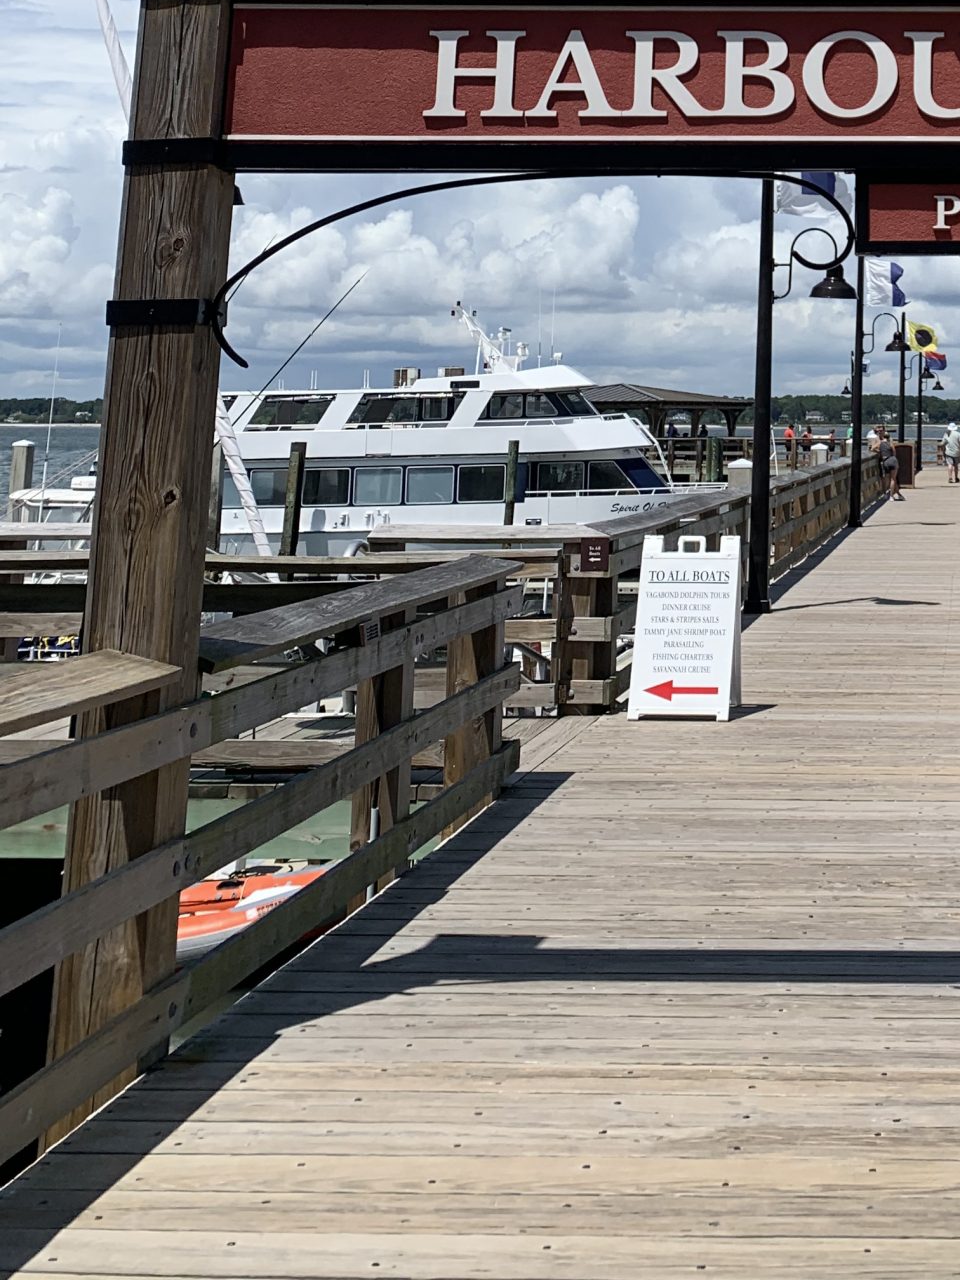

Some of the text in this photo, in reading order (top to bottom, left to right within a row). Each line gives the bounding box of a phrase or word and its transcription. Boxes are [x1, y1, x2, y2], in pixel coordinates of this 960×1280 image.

[610, 502, 640, 514] Spirit
[648, 570, 730, 582] TO ALL BOATS
[646, 591, 730, 599] VAGABOND DOLPHIN TOURS
[661, 603, 711, 611] DINNER CRUISE
[650, 615, 720, 624] STARS & STRIPES SAILS
[644, 628, 727, 637] TAMMY JANE SHRIMP BOAT
[663, 640, 705, 648] PARASAILING
[652, 652, 714, 661] FISHING CHARTERS
[652, 665, 711, 674] SAVANNAH CRUISE
